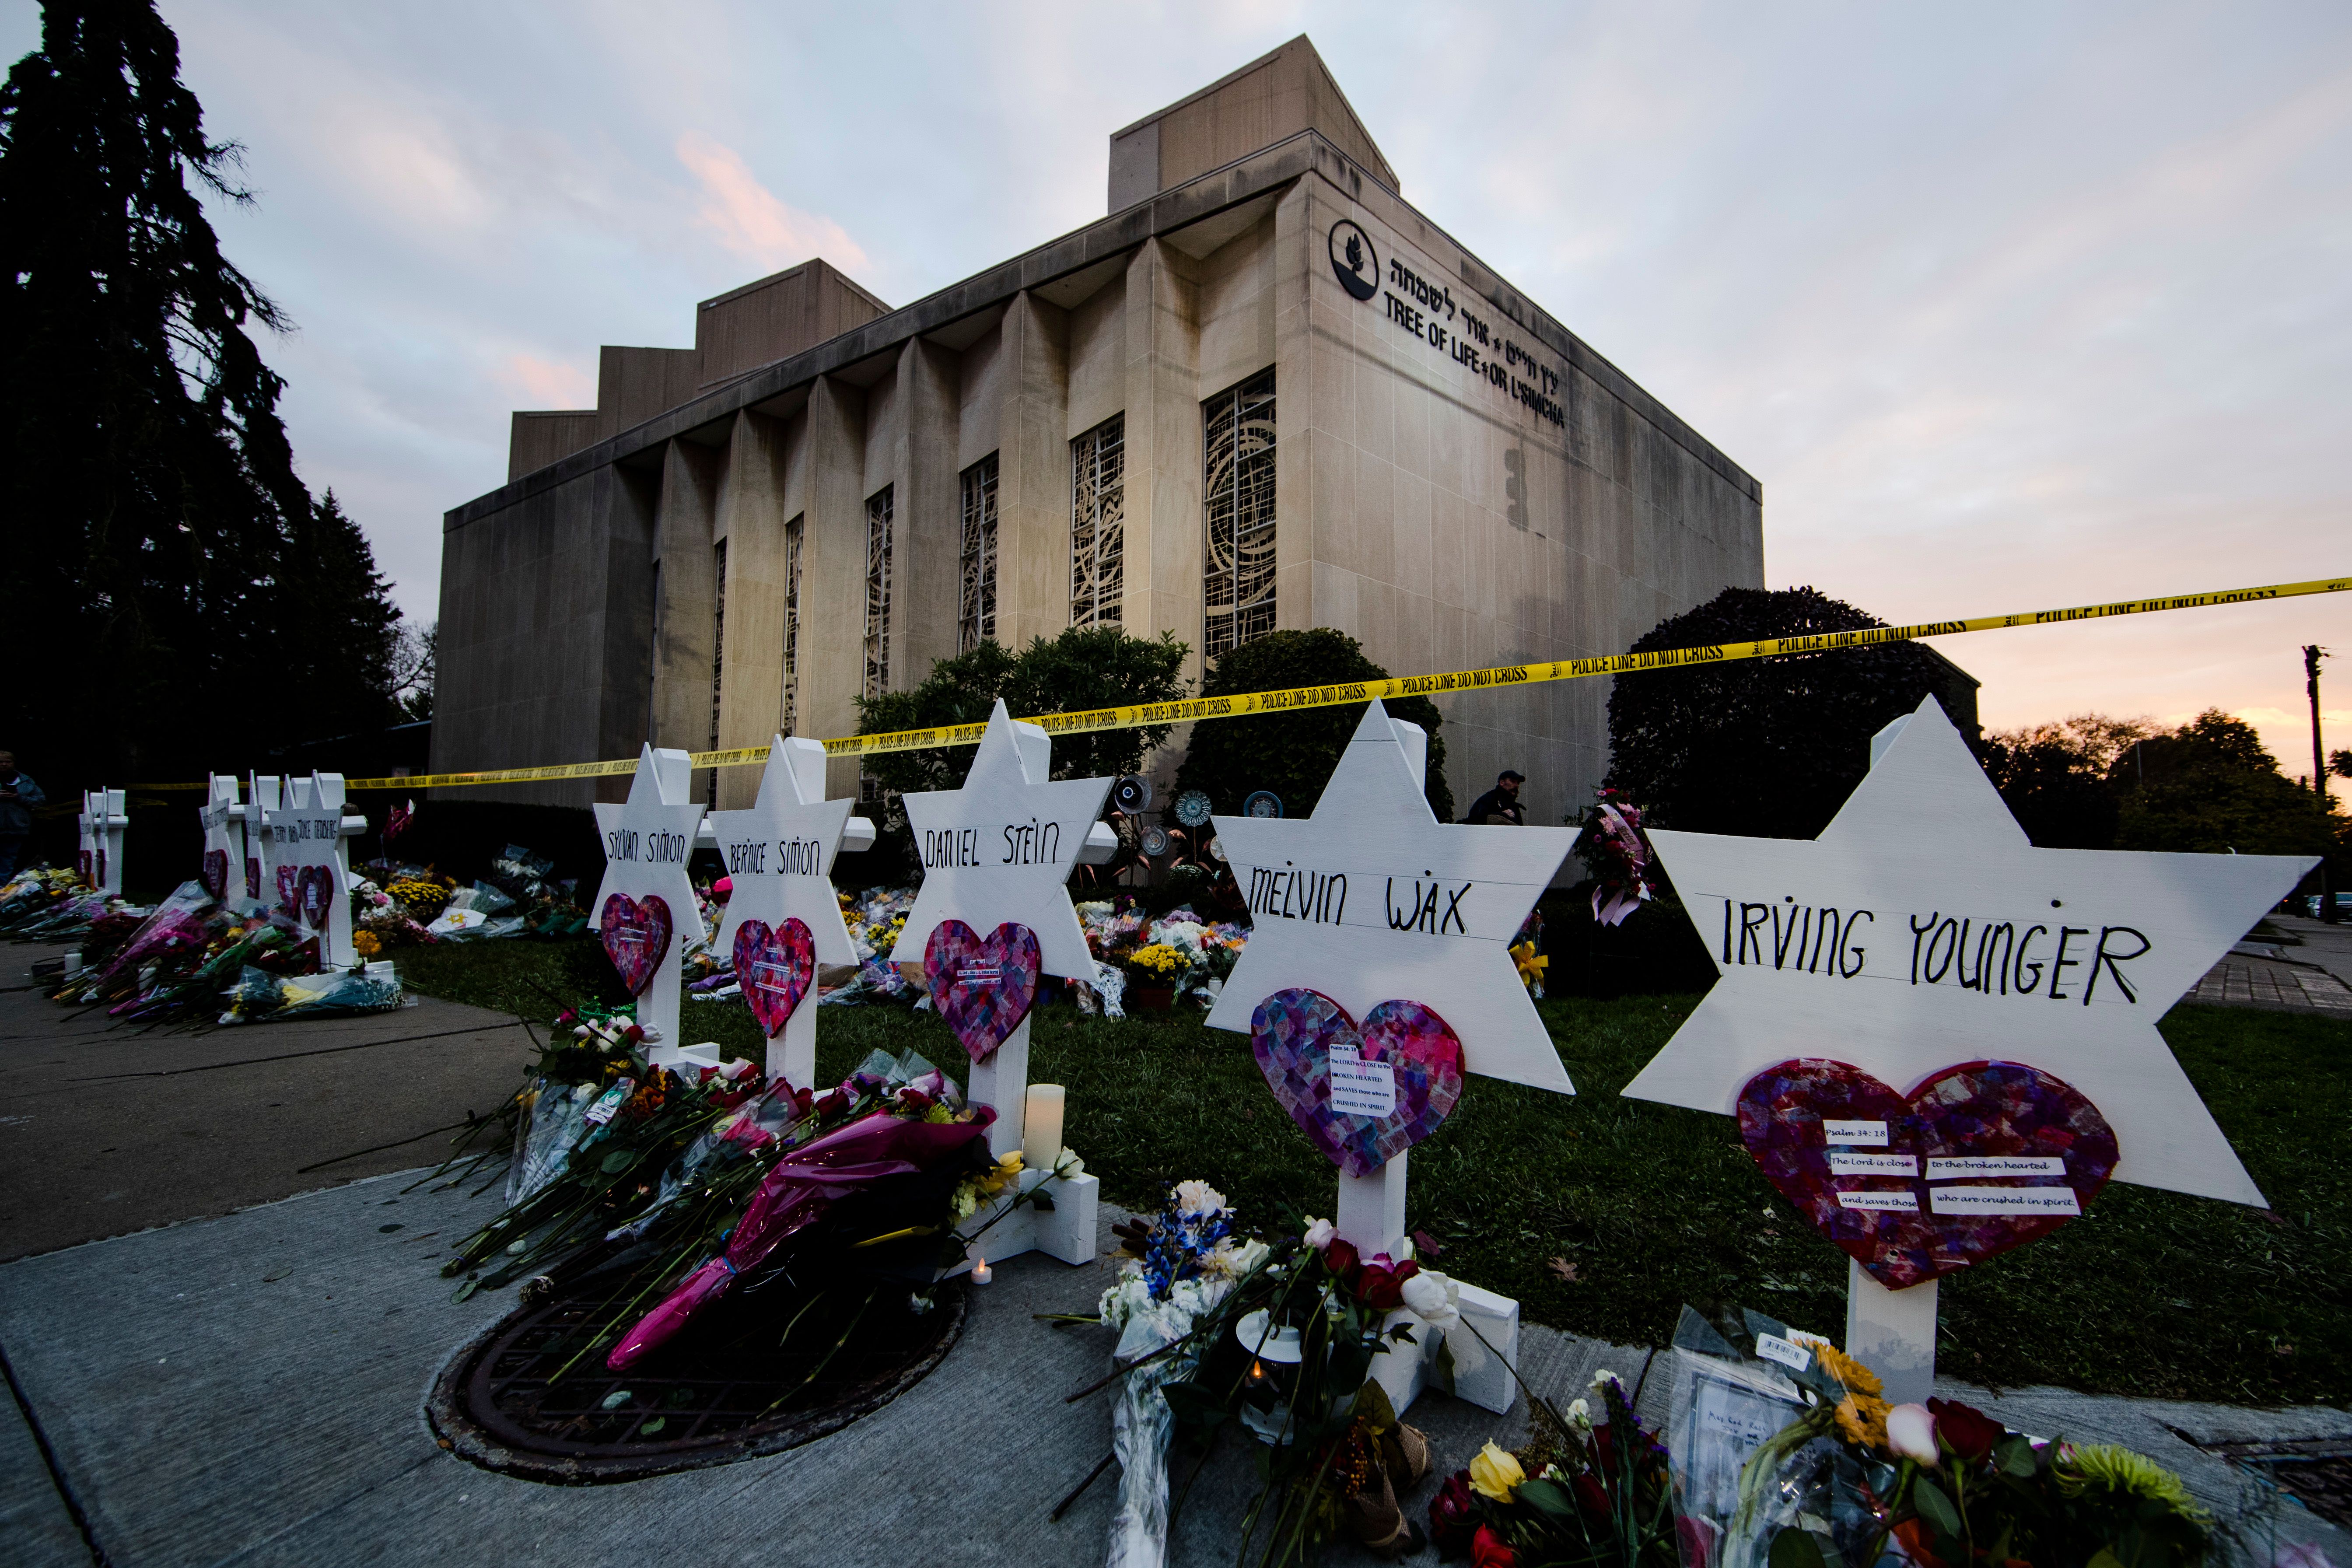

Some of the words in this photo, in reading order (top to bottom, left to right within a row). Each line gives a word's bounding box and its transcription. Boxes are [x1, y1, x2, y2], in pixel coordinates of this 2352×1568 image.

[1384, 291, 1424, 338] TREE
[1428, 322, 1447, 351] OF
[1452, 336, 1480, 374] LIFE
[1490, 363, 1508, 392] OR
[1512, 376, 1564, 429] L'SIMCHA
[1572, 657, 1609, 675] POLICE
[1612, 655, 1636, 671] LINE
[1639, 652, 1654, 668] DO
[1658, 650, 1679, 665] NOT
[1683, 646, 1723, 662] CROSS
[1401, 676, 1433, 694] POLICE
[1435, 674, 1456, 690] LINE
[1458, 672, 1471, 687] DO
[1474, 670, 1492, 686] NOT
[1495, 666, 1527, 683] CROSS
[1261, 693, 1288, 709] POLICE
[1288, 690, 1306, 706] LINE
[1307, 688, 1319, 704] DO
[1320, 687, 1336, 702] NOT
[1338, 684, 1366, 701] CROSS
[1041, 716, 1060, 732] POLICE
[1061, 715, 1074, 730] LINE
[1075, 714, 1083, 729] DO
[1085, 713, 1096, 728] NOT
[1097, 710, 1117, 727] CROSS
[1142, 706, 1165, 722] POLICE
[1166, 704, 1181, 720] LINE
[1181, 702, 1191, 718] DO
[1192, 701, 1206, 717] NOT
[1208, 698, 1231, 716] CROSS
[878, 735, 893, 749] POLICE
[894, 734, 903, 748] LINE
[904, 733, 911, 747] DO
[921, 731, 935, 745] CROSS
[954, 726, 970, 742] POLICE
[971, 725, 983, 740] LINE
[834, 740, 840, 753] DO
[840, 740, 849, 752] NOT
[849, 739, 863, 752] CROSS
[298, 819, 311, 839] JOYCE
[609, 828, 639, 861] SYLVAN
[648, 832, 686, 864] SIMON
[925, 827, 980, 868] DANIEL
[1002, 822, 1060, 865] STEIN
[730, 842, 766, 875] BERNICE
[777, 840, 820, 876] SIMON
[1249, 867, 1347, 926] MELVIN
[1385, 877, 1472, 934] WAX
[1722, 899, 1874, 980] IRVING
[1910, 911, 2151, 1005] YOUNGER
[1333, 1099, 1358, 1107] CRUSHED
[1891, 1198, 1918, 1207] those
[1982, 1196, 2026, 1204] crushed
[2043, 1198, 2075, 1208] spirit.
